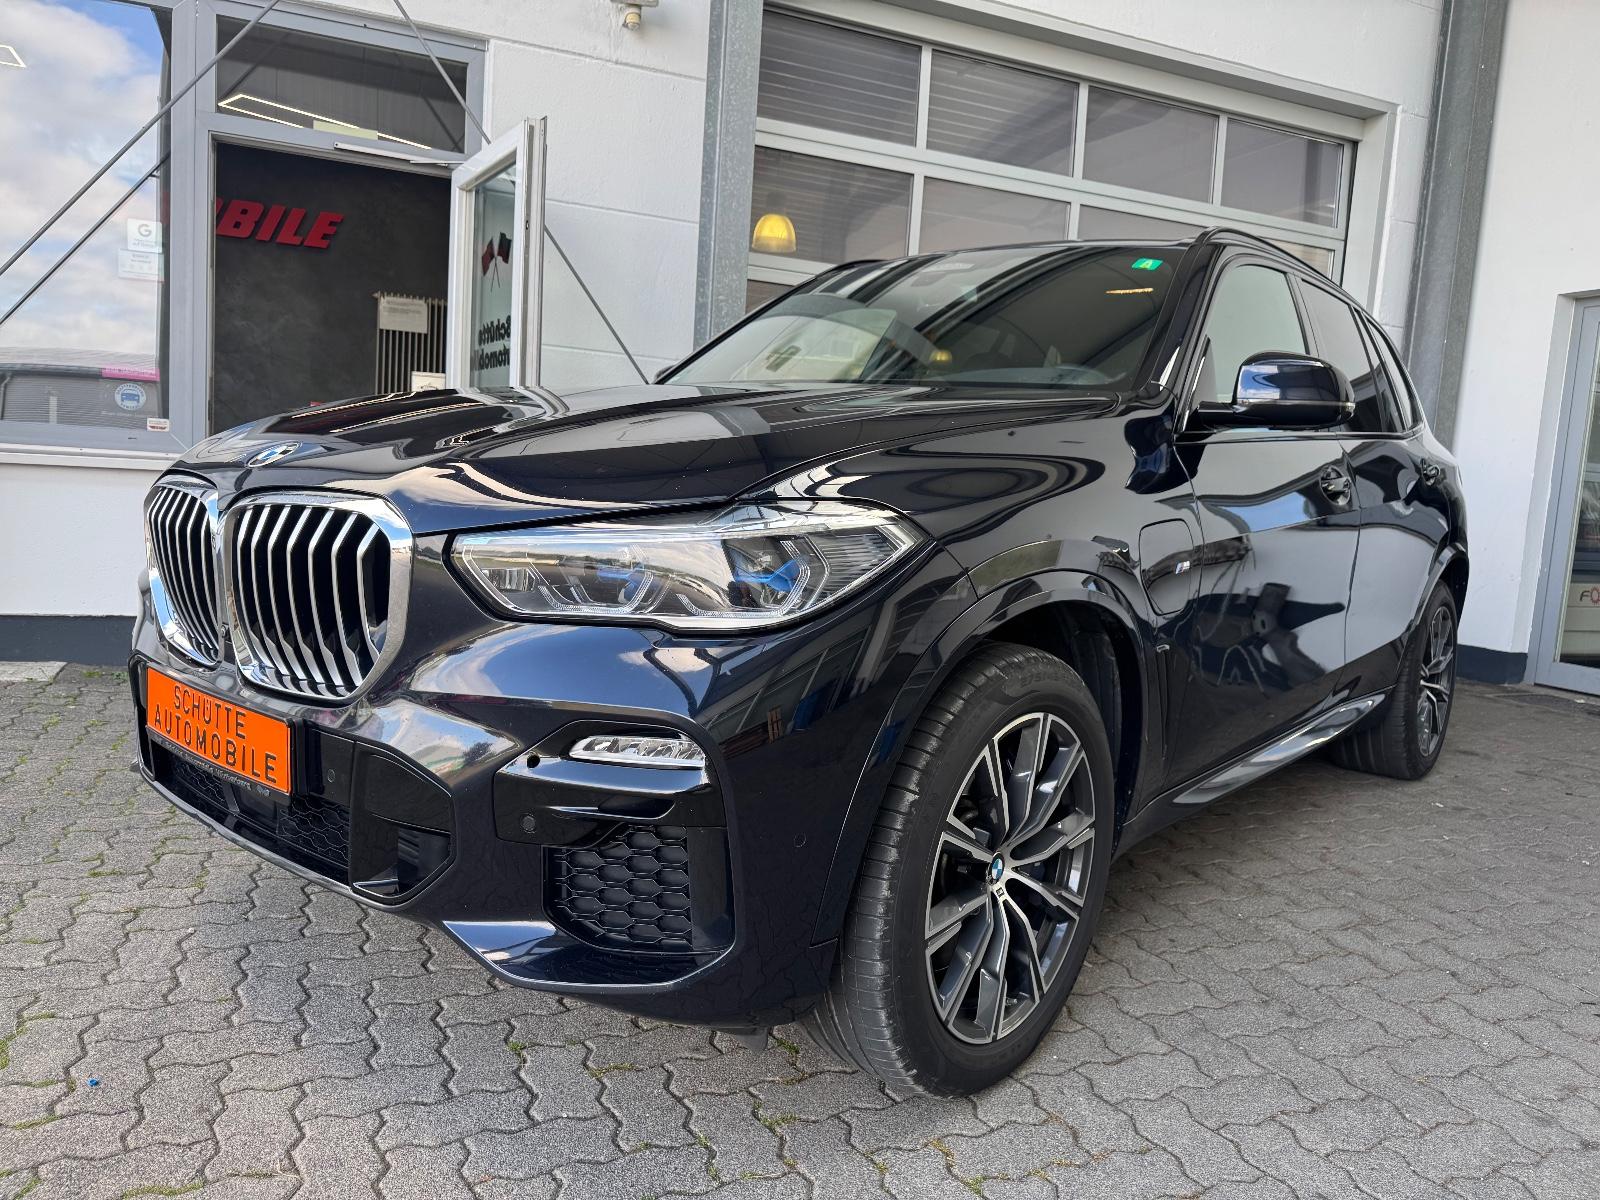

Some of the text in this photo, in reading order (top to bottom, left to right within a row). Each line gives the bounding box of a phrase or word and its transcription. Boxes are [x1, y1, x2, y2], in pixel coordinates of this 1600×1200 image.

[216, 197, 345, 249] BILE
[174, 685, 246, 740] SCHÜTTE
[155, 704, 277, 783] AUTOMOBILE
